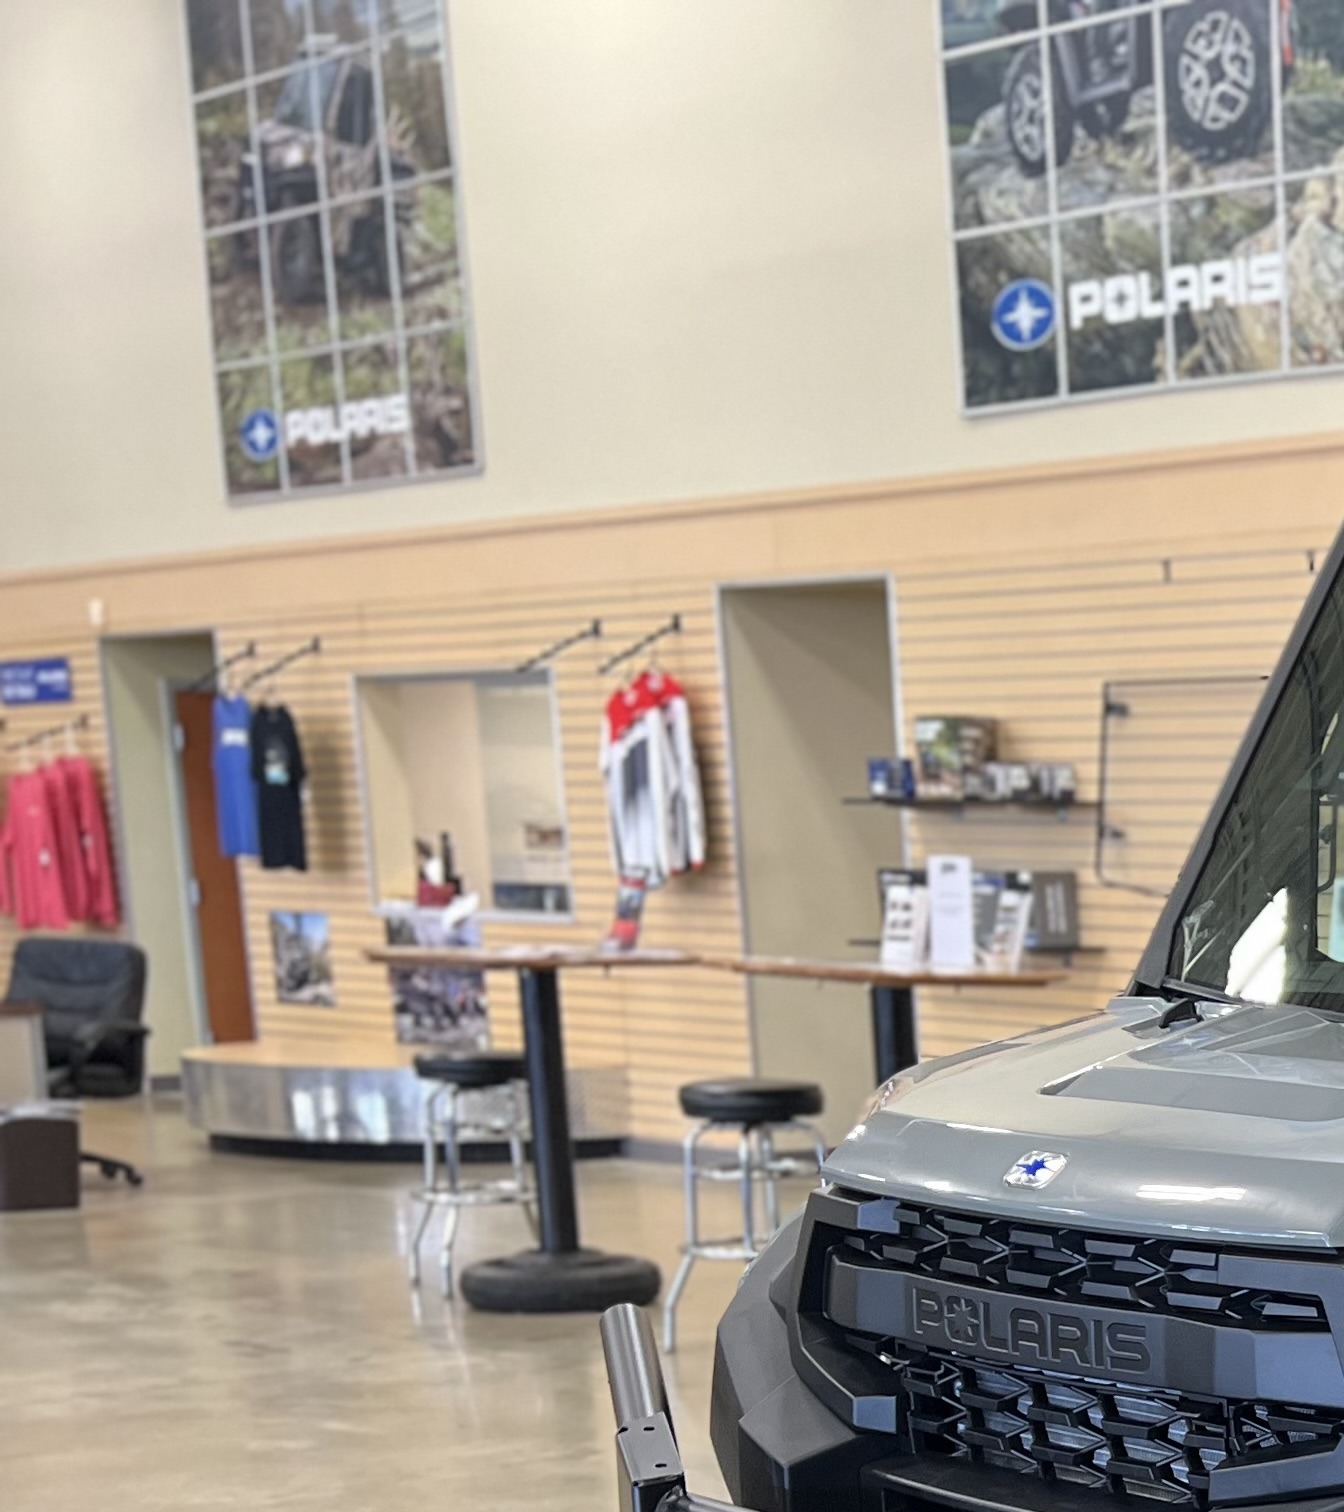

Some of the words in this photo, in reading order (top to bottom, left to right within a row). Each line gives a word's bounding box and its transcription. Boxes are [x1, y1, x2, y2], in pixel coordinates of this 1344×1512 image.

[1068, 251, 1284, 331] POLARIS
[285, 393, 409, 449] POLARIS
[912, 1287, 1151, 1375] POLARIS
